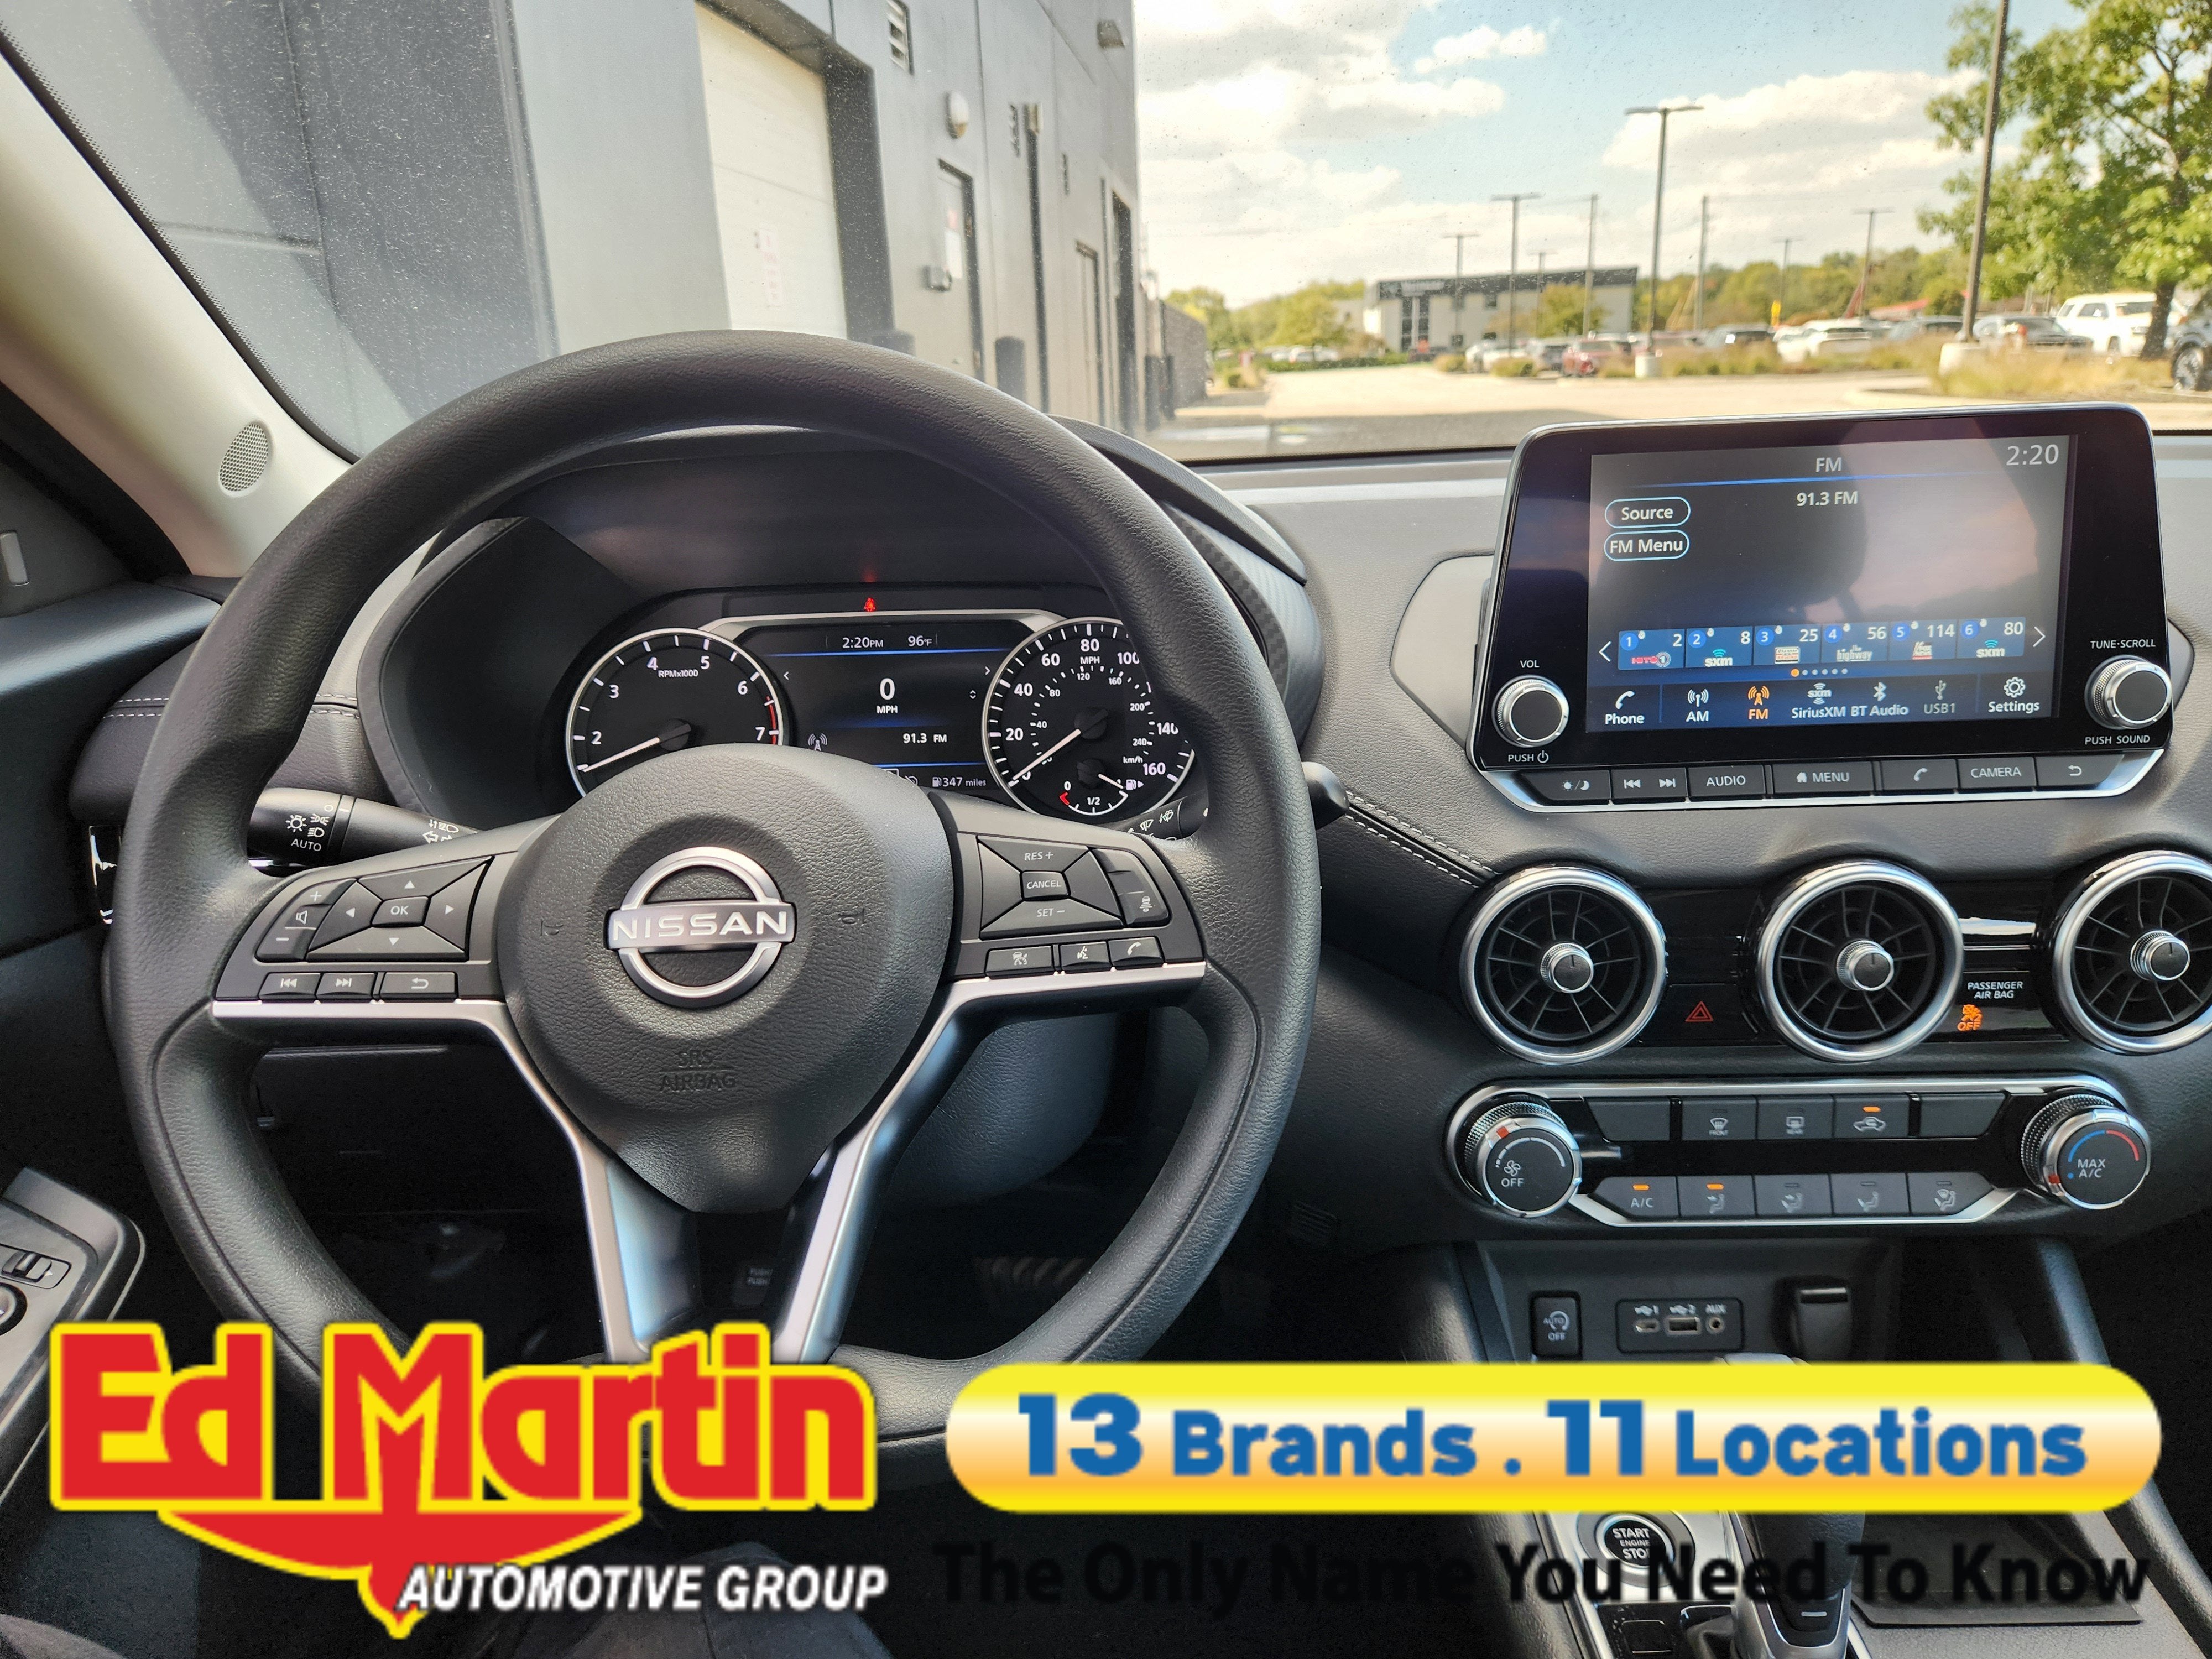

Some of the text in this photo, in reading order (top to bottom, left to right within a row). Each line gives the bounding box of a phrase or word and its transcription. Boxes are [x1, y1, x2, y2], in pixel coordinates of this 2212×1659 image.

[2006, 444, 2059, 467] 2:20
[1815, 457, 1843, 472] FM
[1797, 491, 1859, 507] 91.3 FM
[1621, 505, 1674, 521] Source
[1610, 538, 1684, 554] FM Menu
[1828, 629, 1837, 639] 4
[1867, 627, 1886, 640] 56
[1897, 627, 1904, 638] 5
[1927, 624, 1955, 638] 114
[1965, 624, 1973, 635] 6
[2004, 622, 2023, 635] 80
[1626, 636, 1632, 646] 1
[1673, 633, 1682, 646] 2
[1692, 634, 1700, 645] 2
[1740, 631, 1751, 644] 8
[1761, 632, 1768, 642] 3
[1799, 629, 1818, 642] 25
[1080, 638, 1100, 652] 80
[647, 656, 658, 671] 4
[701, 655, 710, 670] 5
[1041, 653, 1060, 666] 60
[1080, 656, 1100, 664] MPH
[1117, 652, 1140, 665] 100
[1520, 660, 1540, 669] VOL
[658, 669, 698, 678] RPMx1000
[1077, 672, 1091, 681] 120
[609, 685, 619, 698] 3
[737, 681, 748, 695] 6
[879, 677, 895, 700] 0
[1014, 683, 1033, 696] 40
[877, 705, 898, 714] MPH
[1130, 703, 1145, 711] 200
[1791, 706, 1846, 719] SiriusXM
[1851, 704, 1909, 717] BT Audio
[1923, 703, 1956, 714] USB1
[1988, 701, 2039, 714] Settings
[1605, 713, 1645, 725] Phone
[1686, 711, 1709, 722] AM
[1749, 709, 1768, 720] FM
[591, 731, 602, 745] 2
[755, 727, 765, 741] 7
[902, 733, 947, 744] 91.3 FM
[1005, 727, 1024, 740] 20
[1133, 738, 1147, 746] 240
[2085, 735, 2150, 745] PUSH SOUND
[1123, 755, 1143, 764] km/h
[1508, 754, 1534, 763] PUSH
[1142, 763, 1166, 775] 160
[1970, 766, 2022, 778] CAMERA
[942, 777, 987, 787] 347 miles
[1707, 775, 1746, 787] AUDIO
[1812, 772, 1850, 783] MENU
[1064, 781, 1071, 791] 0
[1087, 797, 1100, 806] 1/2
[291, 838, 322, 852] AUTO
[1024, 852, 1043, 860] RES
[1026, 880, 1062, 889] CANCEL
[390, 905, 409, 916] OK
[1036, 907, 1053, 917] SET
[613, 911, 787, 941] NISSAN
[1967, 981, 2023, 990] PASSENGER
[1974, 990, 2014, 999] AIR BAG
[1957, 1022, 1981, 1031] OFF
[660, 1073, 736, 1092] AIRBAG
[2077, 1159, 2106, 1168] MAX
[2078, 1168, 2102, 1178] A/C
[1501, 1177, 1524, 1188] OFF
[1631, 1197, 1653, 1208] A/C
[1612, 1527, 1650, 1538] START
